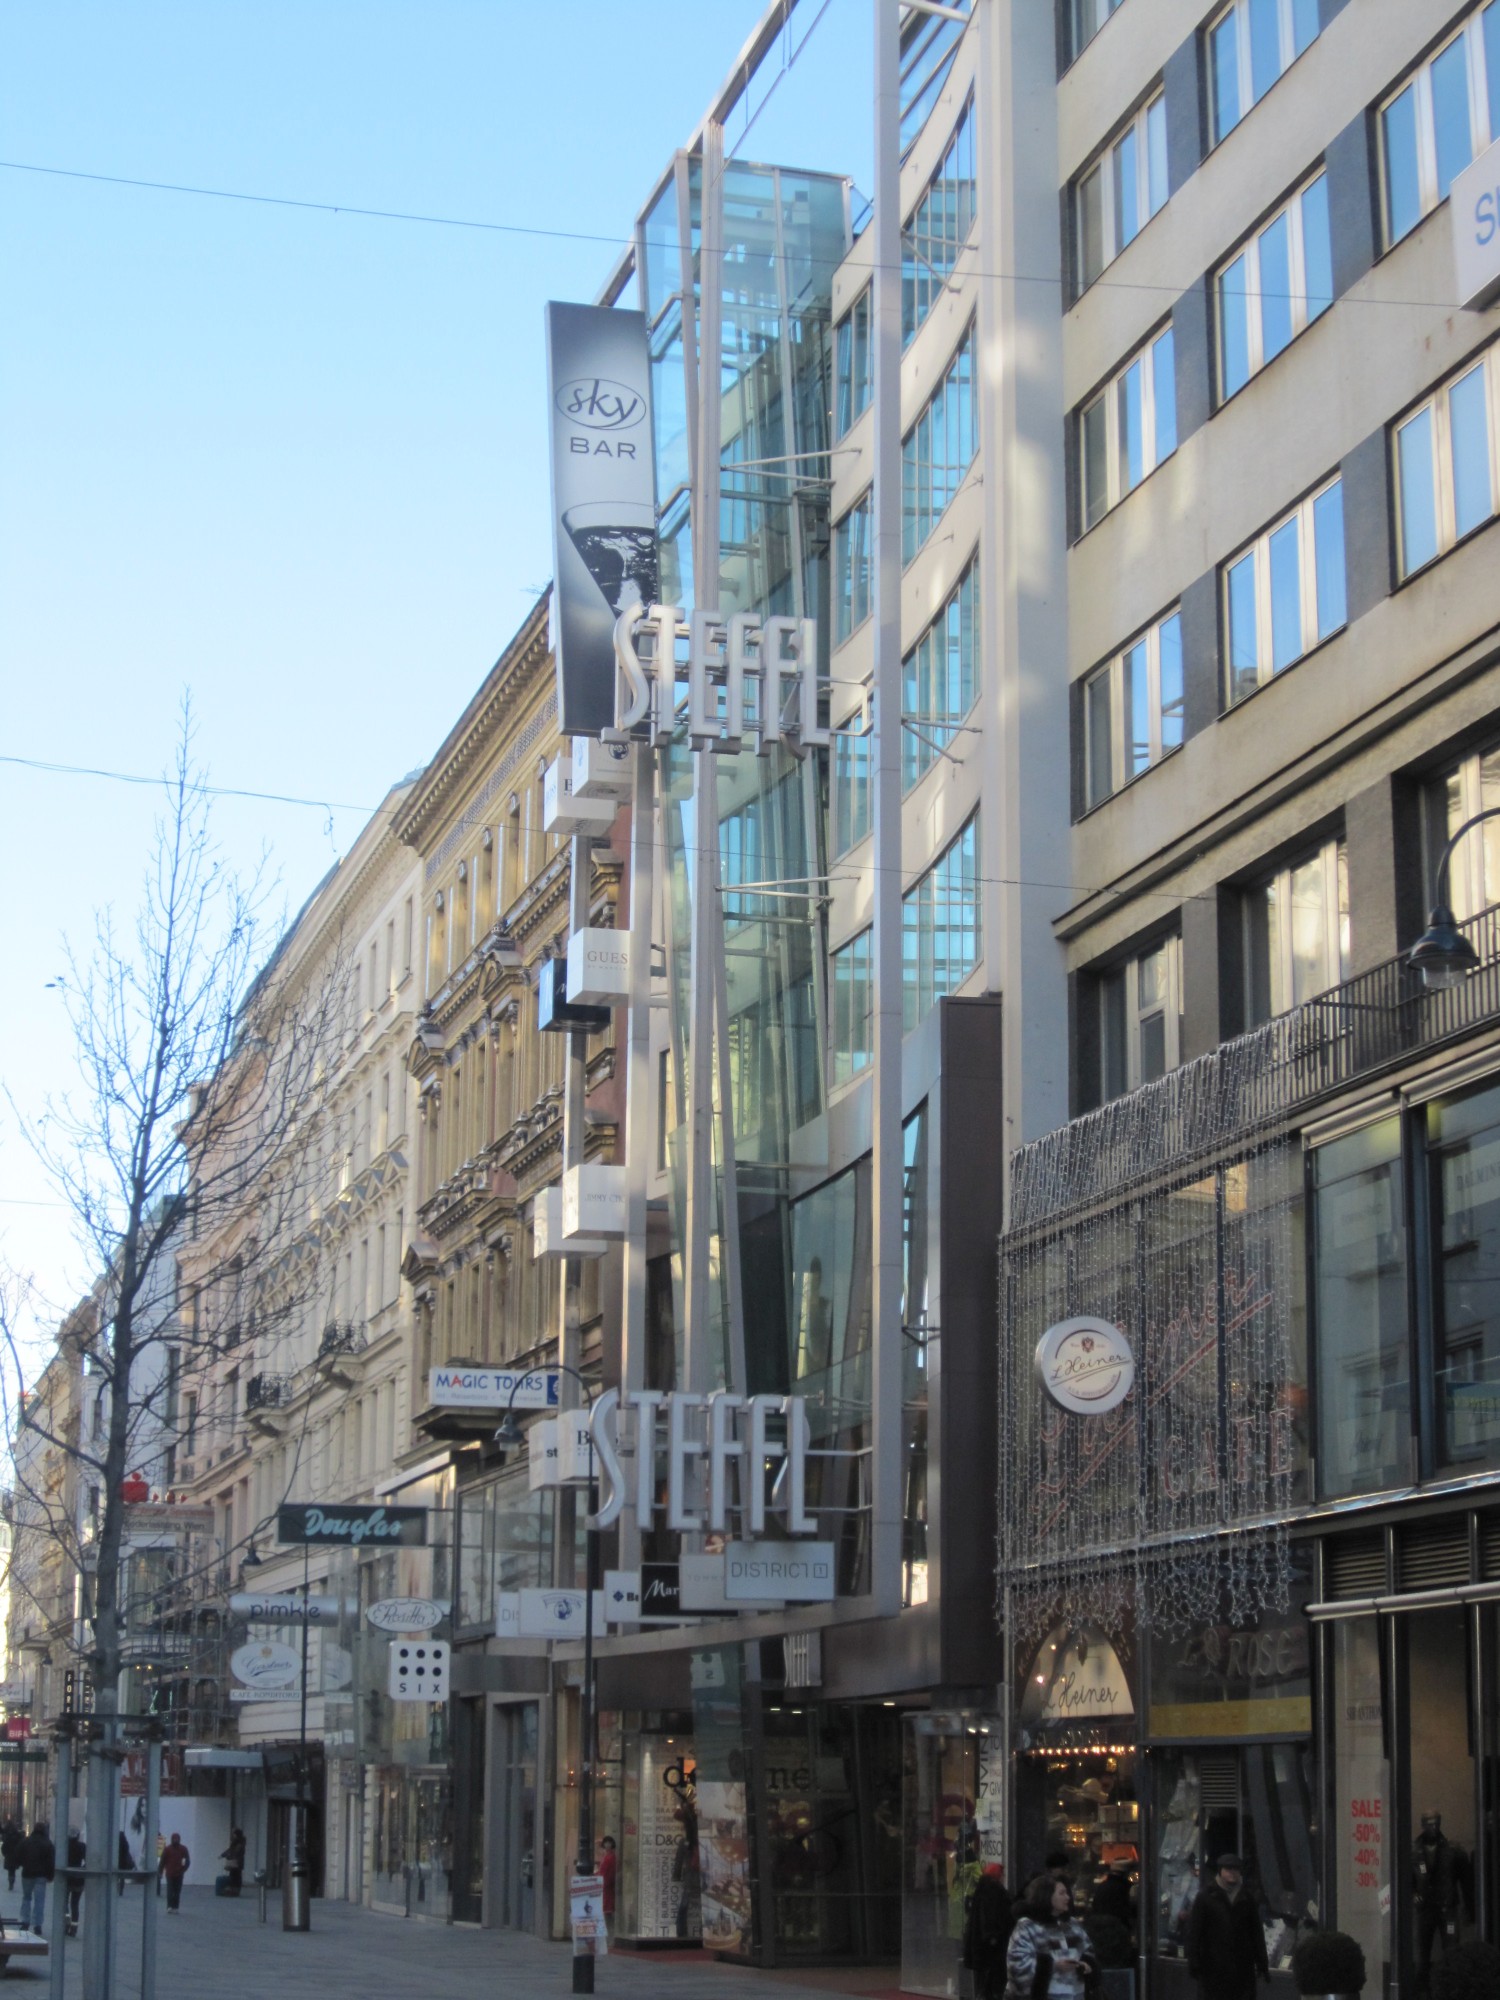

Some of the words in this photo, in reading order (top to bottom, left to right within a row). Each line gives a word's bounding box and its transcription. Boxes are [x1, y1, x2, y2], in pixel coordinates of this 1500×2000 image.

[566, 379, 639, 422] sky
[569, 436, 637, 461] BAR
[612, 602, 831, 746] STEFFL
[1064, 1355, 1126, 1376] Heiner
[435, 1373, 488, 1389] MAGIC
[588, 1386, 818, 1533] STEFFL
[304, 1507, 403, 1545] Douglas
[730, 1561, 809, 1579] DISTRICT
[250, 1598, 321, 1619] pimke
[399, 1682, 440, 1694] SIX
[1351, 1799, 1381, 1818] SALE
[1352, 1823, 1380, 1843] -50%
[1354, 1849, 1379, 1867] -40%
[1355, 1872, 1378, 1888] -30%
